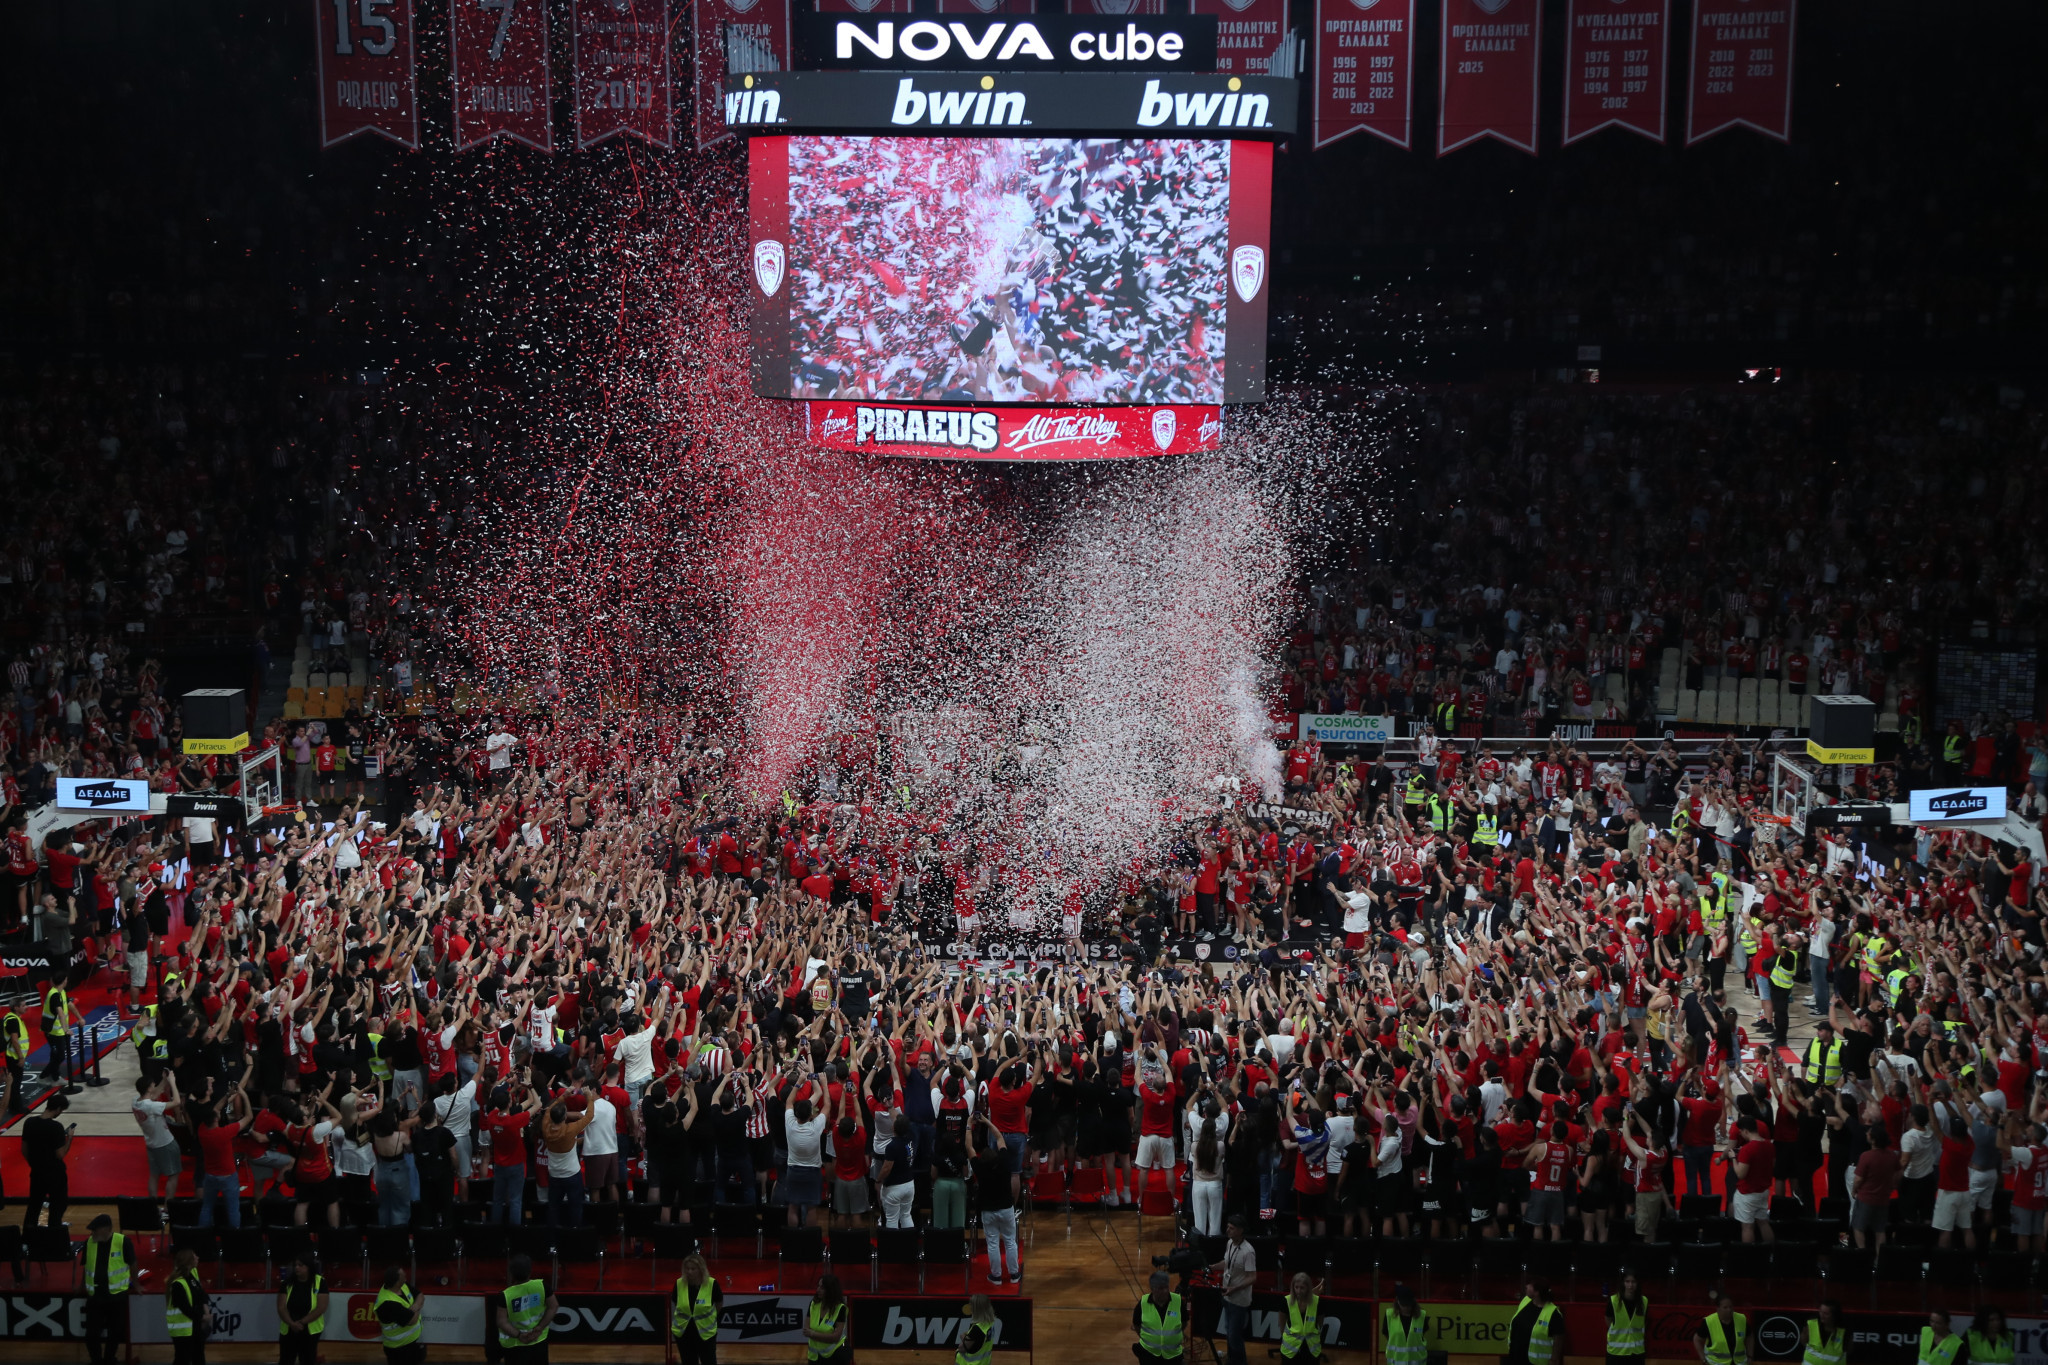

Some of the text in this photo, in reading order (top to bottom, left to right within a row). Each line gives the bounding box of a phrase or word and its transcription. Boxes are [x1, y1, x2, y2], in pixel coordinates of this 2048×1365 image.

[1577, 12, 1659, 27] ΚΥΠΕΛΛΟΥΧΟΣ
[1702, 11, 1786, 26] ΚΥΠΕΛΛΟΥΧΟΣ
[332, 0, 395, 55] 15
[479, 0, 516, 60] 7
[1326, 20, 1404, 33] ΠΡΩΤΑΘΛΗΤΗΣ
[1452, 24, 1530, 38] ΠΡΩΤΑΘΛΗΤΗΣ
[1716, 26, 1770, 41] ΕΛΛΑΔΑΣ
[836, 21, 1184, 61] NOVA cube
[1338, 35, 1390, 47] ΕΛΛΑΔΑΣ
[1591, 28, 1644, 42] ΕΛΛΑΔΑΣ
[1465, 39, 1516, 52] ΕΛΛΑΔΑΣ
[1333, 56, 1394, 69] 1996 1997
[1584, 50, 1648, 63] 1976 1977
[1709, 49, 1773, 63] 2010 2011
[1217, 58, 1269, 69] 49 1960
[1458, 61, 1484, 73] 2025
[1333, 72, 1394, 84] 2012 2015
[1584, 65, 1648, 79] 1978 1980
[1708, 64, 1773, 78] 2022 2023
[337, 80, 399, 108] PIRAEUS
[593, 80, 652, 109] 2013
[1332, 87, 1394, 99] 2016 2022
[1583, 81, 1647, 94] 1994 1997
[1706, 81, 1733, 94] 2024
[472, 85, 533, 112] PIRAEUS
[891, 76, 1026, 125] bwin
[1137, 77, 1270, 127] bwin
[1601, 97, 1628, 109] 2002
[1350, 102, 1375, 114] 2023
[856, 406, 998, 449] PIRAEUS
[1004, 414, 1052, 448] All
[1051, 415, 1079, 438] The
[1078, 413, 1122, 445] Way
[1315, 717, 1379, 728] COSMOTE
[1554, 725, 1637, 738] TEAM OF DESTINY
[1838, 752, 1867, 760] Piraeus
[78, 789, 128, 799] ΔΕΔΔΗΕ
[193, 801, 218, 811] bwin
[1932, 799, 1984, 809] ΔΕΔΔΗΕ
[37, 816, 59, 833] SPALDING
[1837, 813, 1862, 822] bwin
[2002, 827, 2024, 845] SPALDING
[2, 958, 50, 967] NOVA
[212, 1310, 241, 1336] kip
[552, 1307, 655, 1332] OVA
[720, 1311, 798, 1325] ΔΕΔΔΗΕ
[1436, 1316, 1510, 1341] Pirae
[1762, 1331, 1797, 1339] GSA
